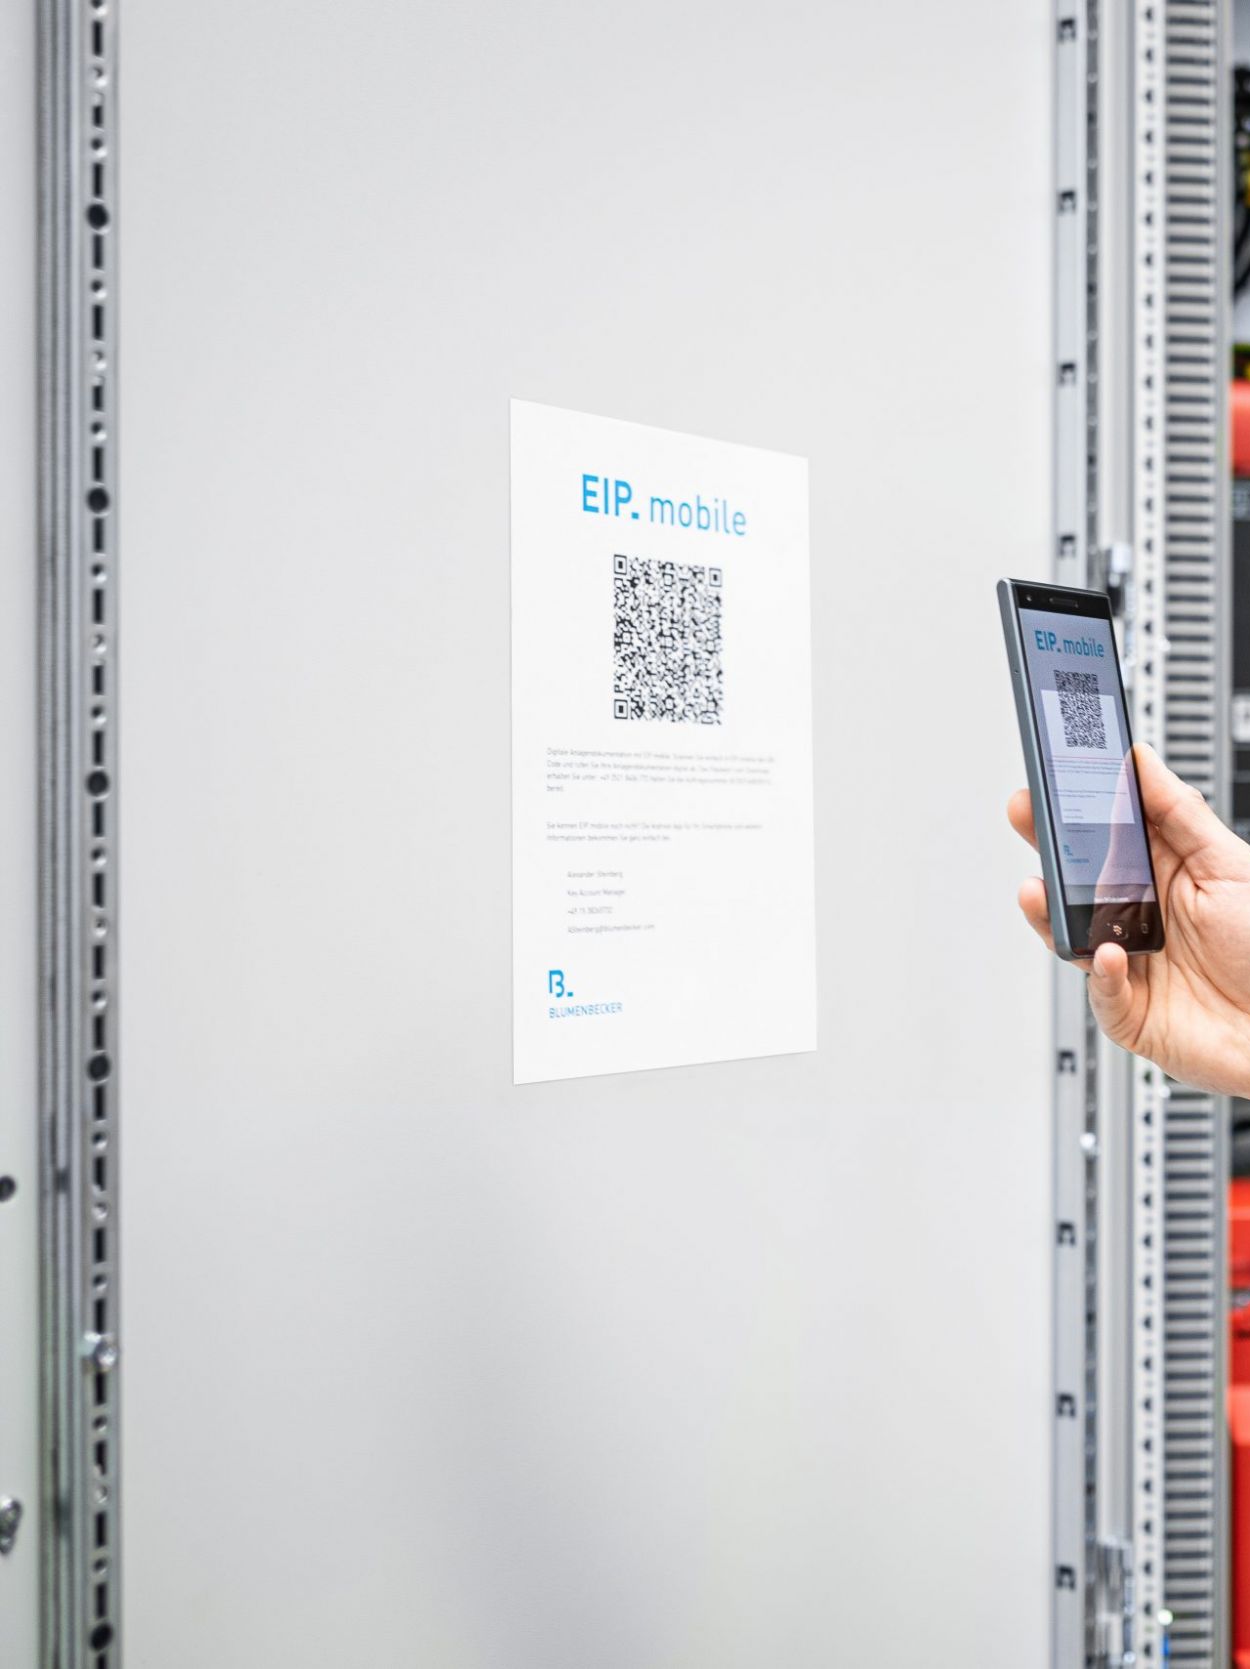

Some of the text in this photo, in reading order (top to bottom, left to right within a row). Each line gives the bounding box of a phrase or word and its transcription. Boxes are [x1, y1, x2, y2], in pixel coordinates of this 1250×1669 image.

[582, 473, 747, 536] EIP. mobile
[1034, 630, 1105, 658] EIP. mobile
[549, 1001, 623, 1019] BLUMENBECKER
